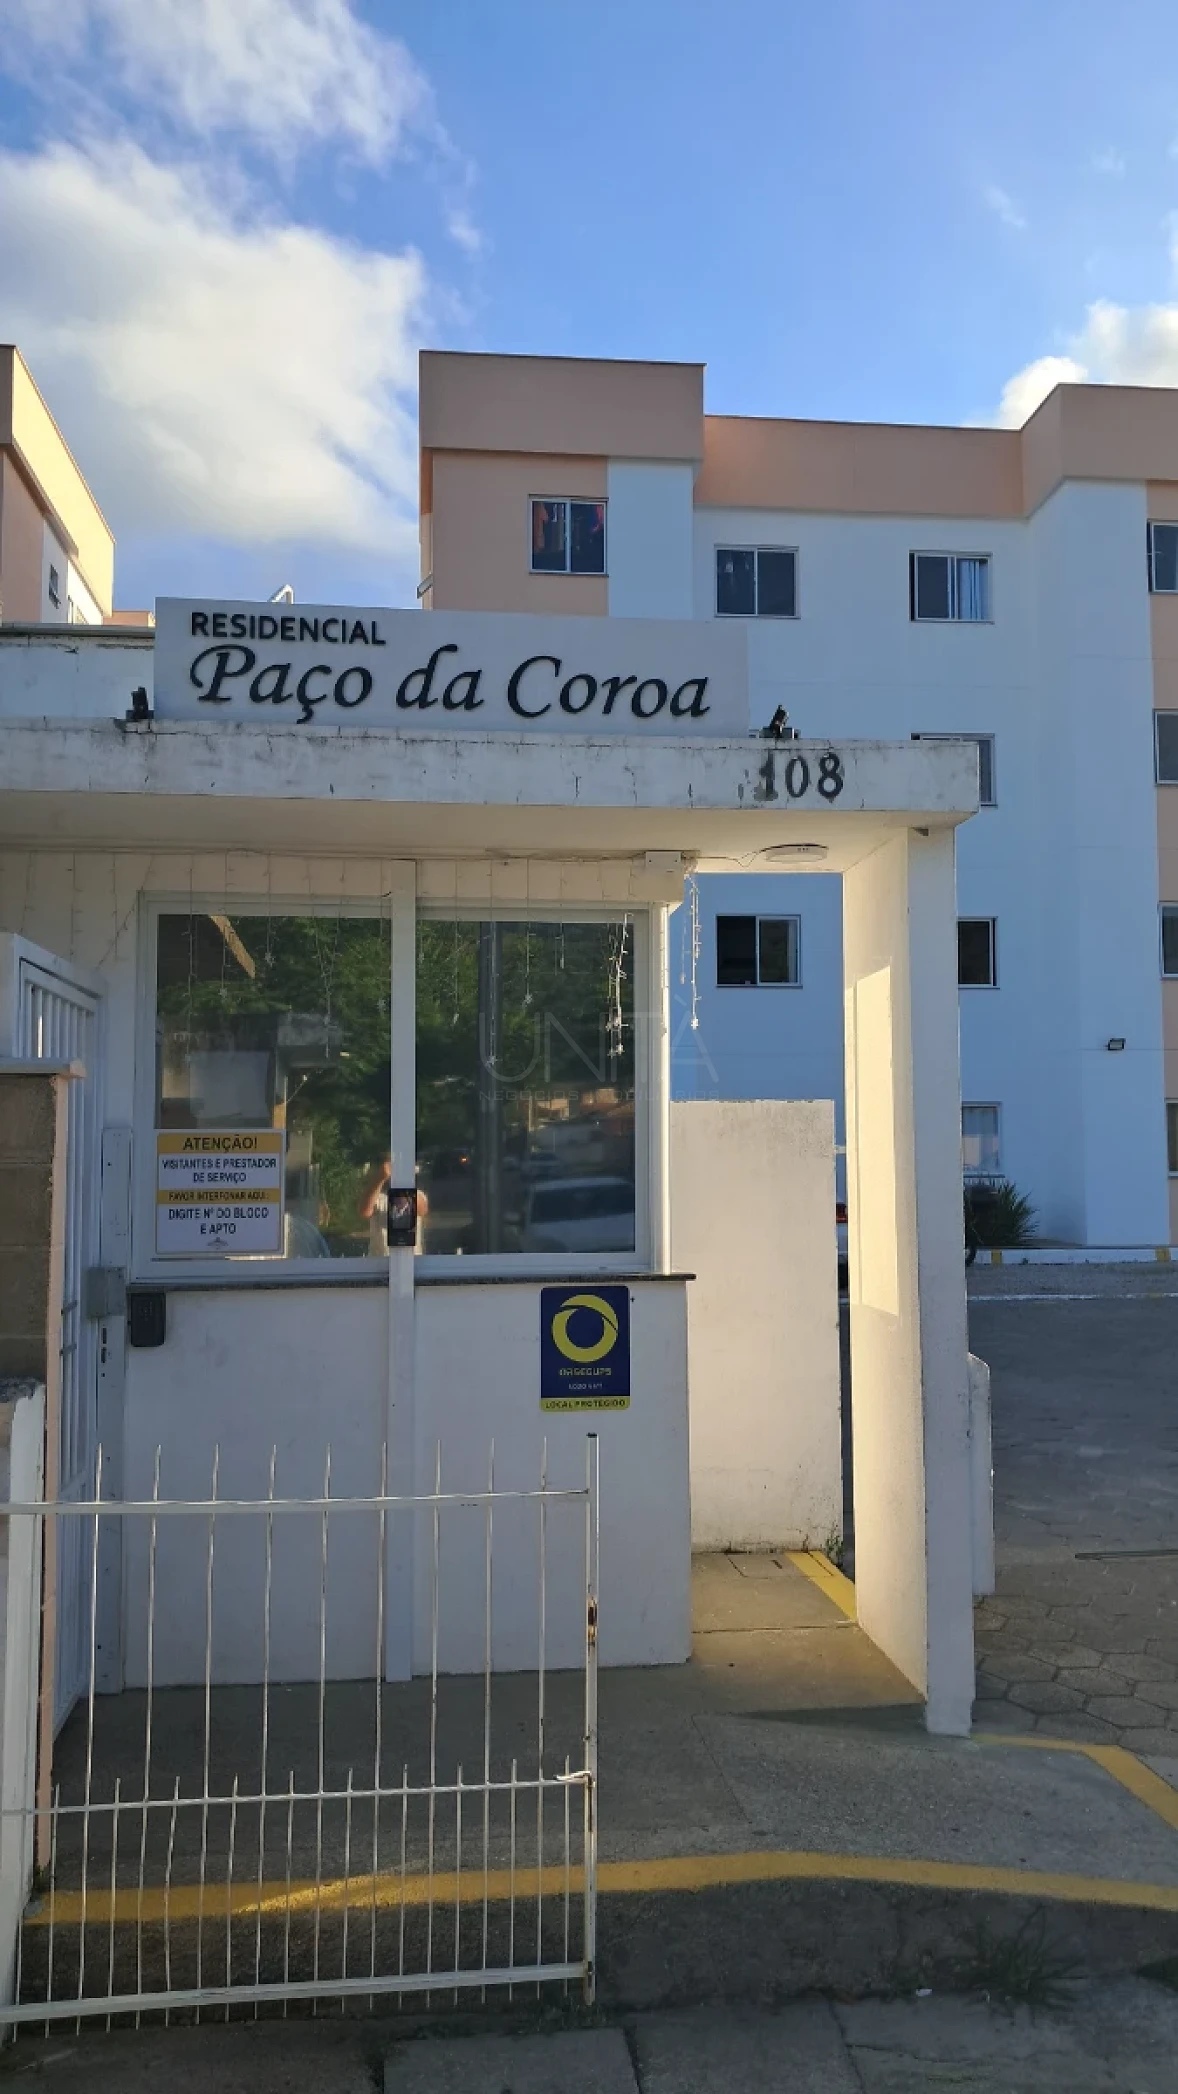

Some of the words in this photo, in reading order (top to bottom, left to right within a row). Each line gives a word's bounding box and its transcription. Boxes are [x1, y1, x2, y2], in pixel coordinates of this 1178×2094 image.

[191, 612, 386, 645] RESIDENCIAL
[190, 643, 373, 725] Paço
[396, 643, 484, 711] da
[507, 655, 711, 718] Coroa
[758, 750, 845, 802] 108
[183, 1134, 258, 1153] ATENÇÃO!
[223, 1158, 277, 1169] PRESTADOR
[193, 1172, 205, 1183] DE
[207, 1172, 247, 1184] SERVIÇO
[168, 1208, 201, 1221] DIGITE
[217, 1207, 231, 1219] DO
[233, 1207, 269, 1219] BLOCO
[200, 1223, 207, 1235] E
[209, 1223, 236, 1235] APTO
[545, 1400, 573, 1409] LOCAL
